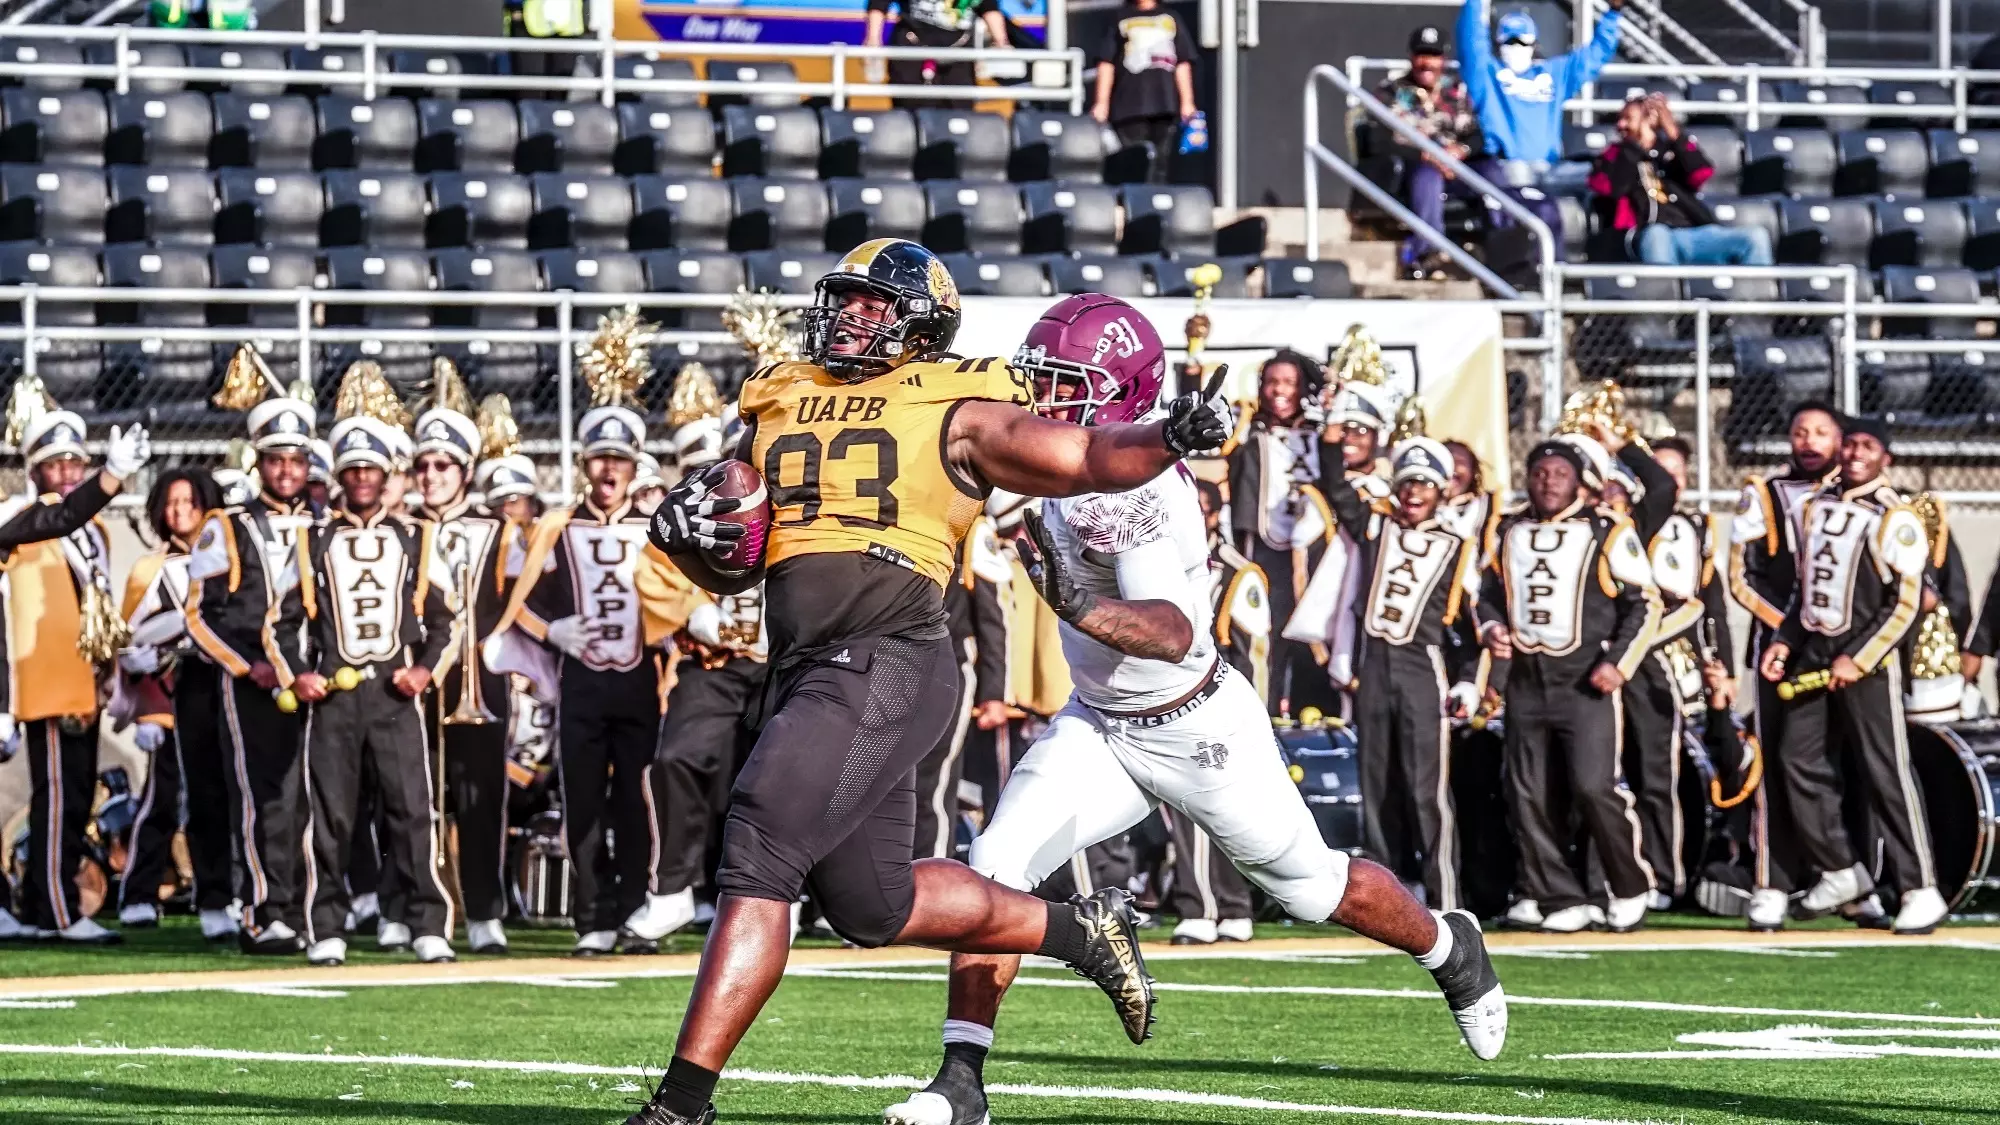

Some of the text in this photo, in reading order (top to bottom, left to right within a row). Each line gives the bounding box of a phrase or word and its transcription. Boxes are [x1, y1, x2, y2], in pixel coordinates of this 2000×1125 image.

[1104, 316, 1144, 359] 31
[796, 395, 888, 425] UAPB
[1004, 364, 1036, 411] 9
[764, 427, 899, 531] 93
[345, 535, 388, 641] UAPB
[588, 537, 631, 641] UAPB
[1380, 529, 1434, 623] UAPB
[1525, 528, 1568, 625] UAPB
[1811, 507, 1855, 608] UAPB
